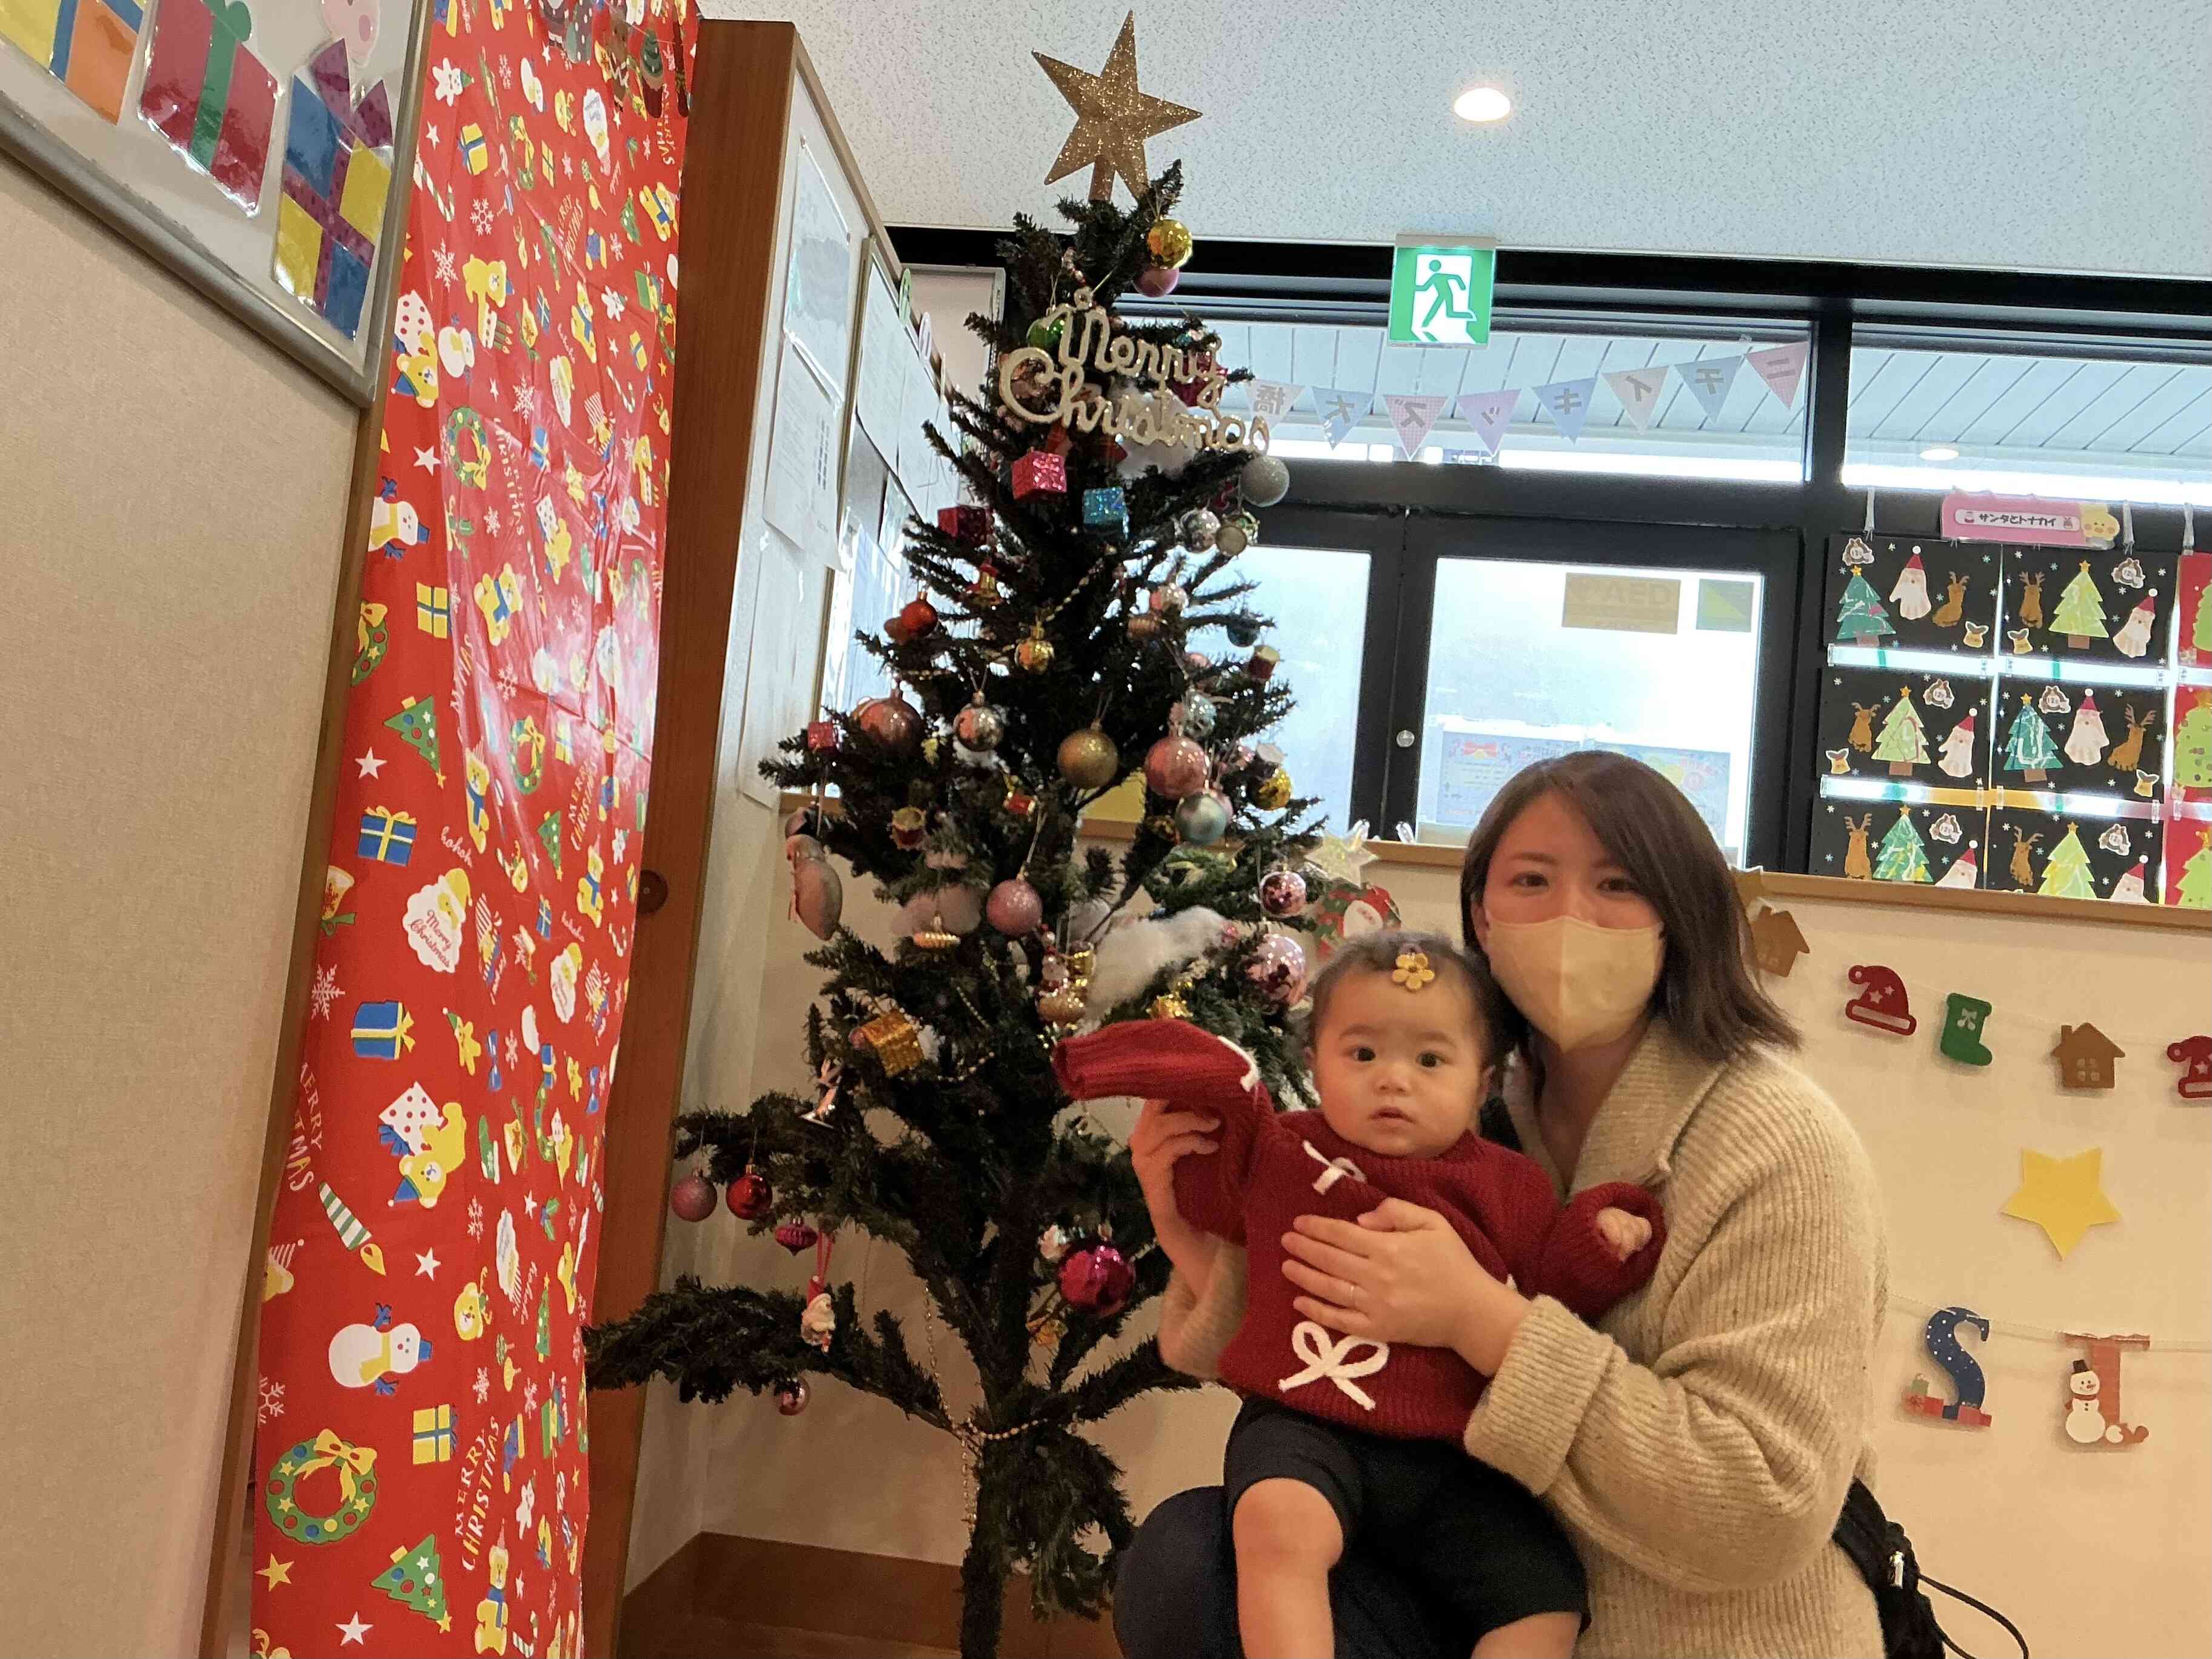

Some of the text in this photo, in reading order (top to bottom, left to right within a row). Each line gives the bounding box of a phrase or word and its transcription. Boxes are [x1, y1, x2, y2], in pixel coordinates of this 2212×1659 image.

[999, 347, 1271, 456] Christmas
[1042, 302, 1223, 409] Merry
[1979, 513, 2057, 527] サンタとトナカイ
[409, 918, 450, 967] Christmas
[427, 909, 452, 951] Merry
[455, 1428, 486, 1537] MERRY
[461, 1416, 499, 1571] CHRISTMAS
